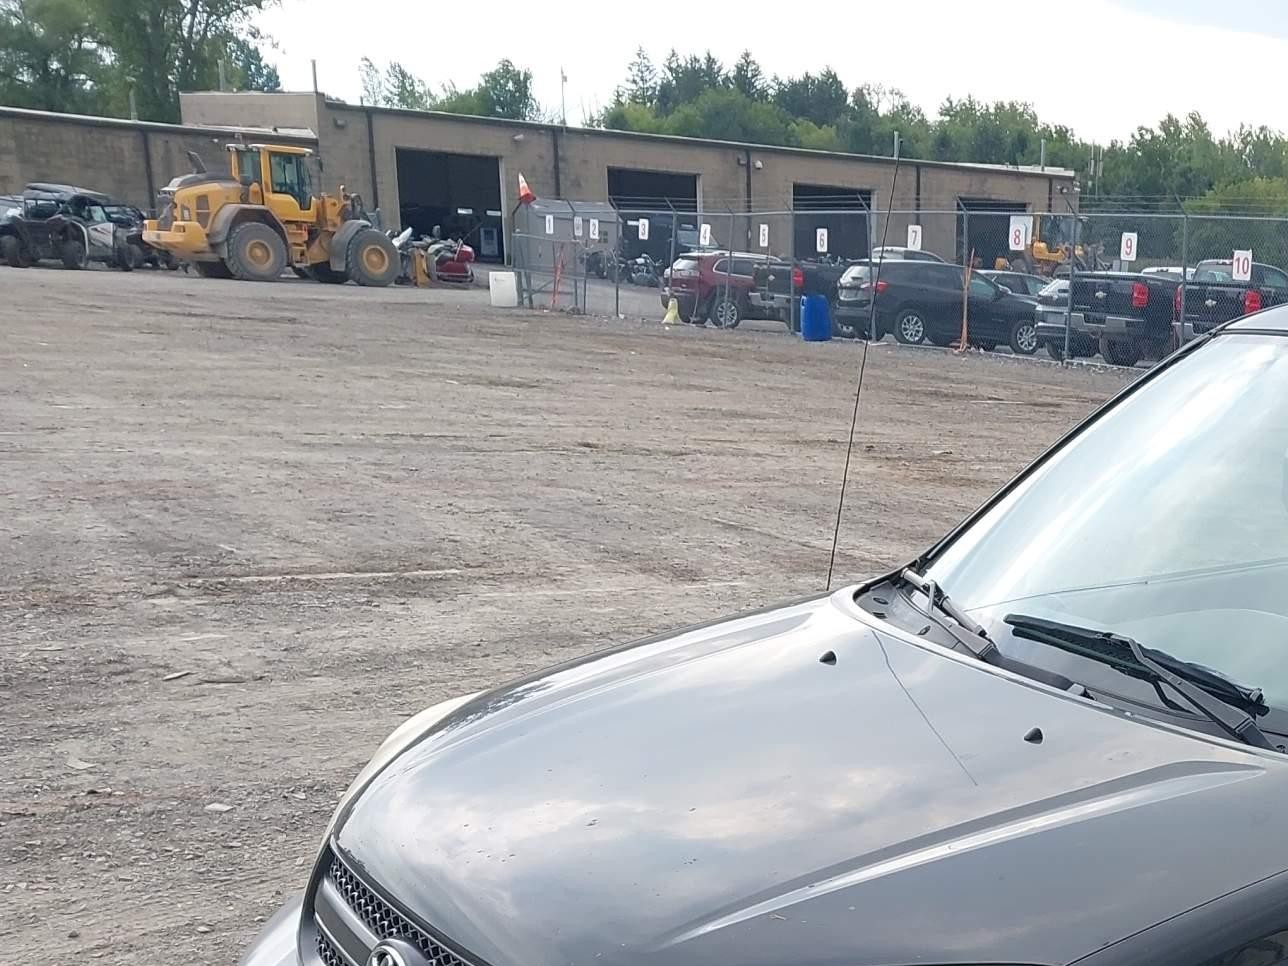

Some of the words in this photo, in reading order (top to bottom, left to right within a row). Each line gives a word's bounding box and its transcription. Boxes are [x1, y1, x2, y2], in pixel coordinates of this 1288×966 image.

[1014, 229, 1021, 246] 8
[1125, 238, 1133, 256] 9
[1234, 256, 1250, 275] 10
